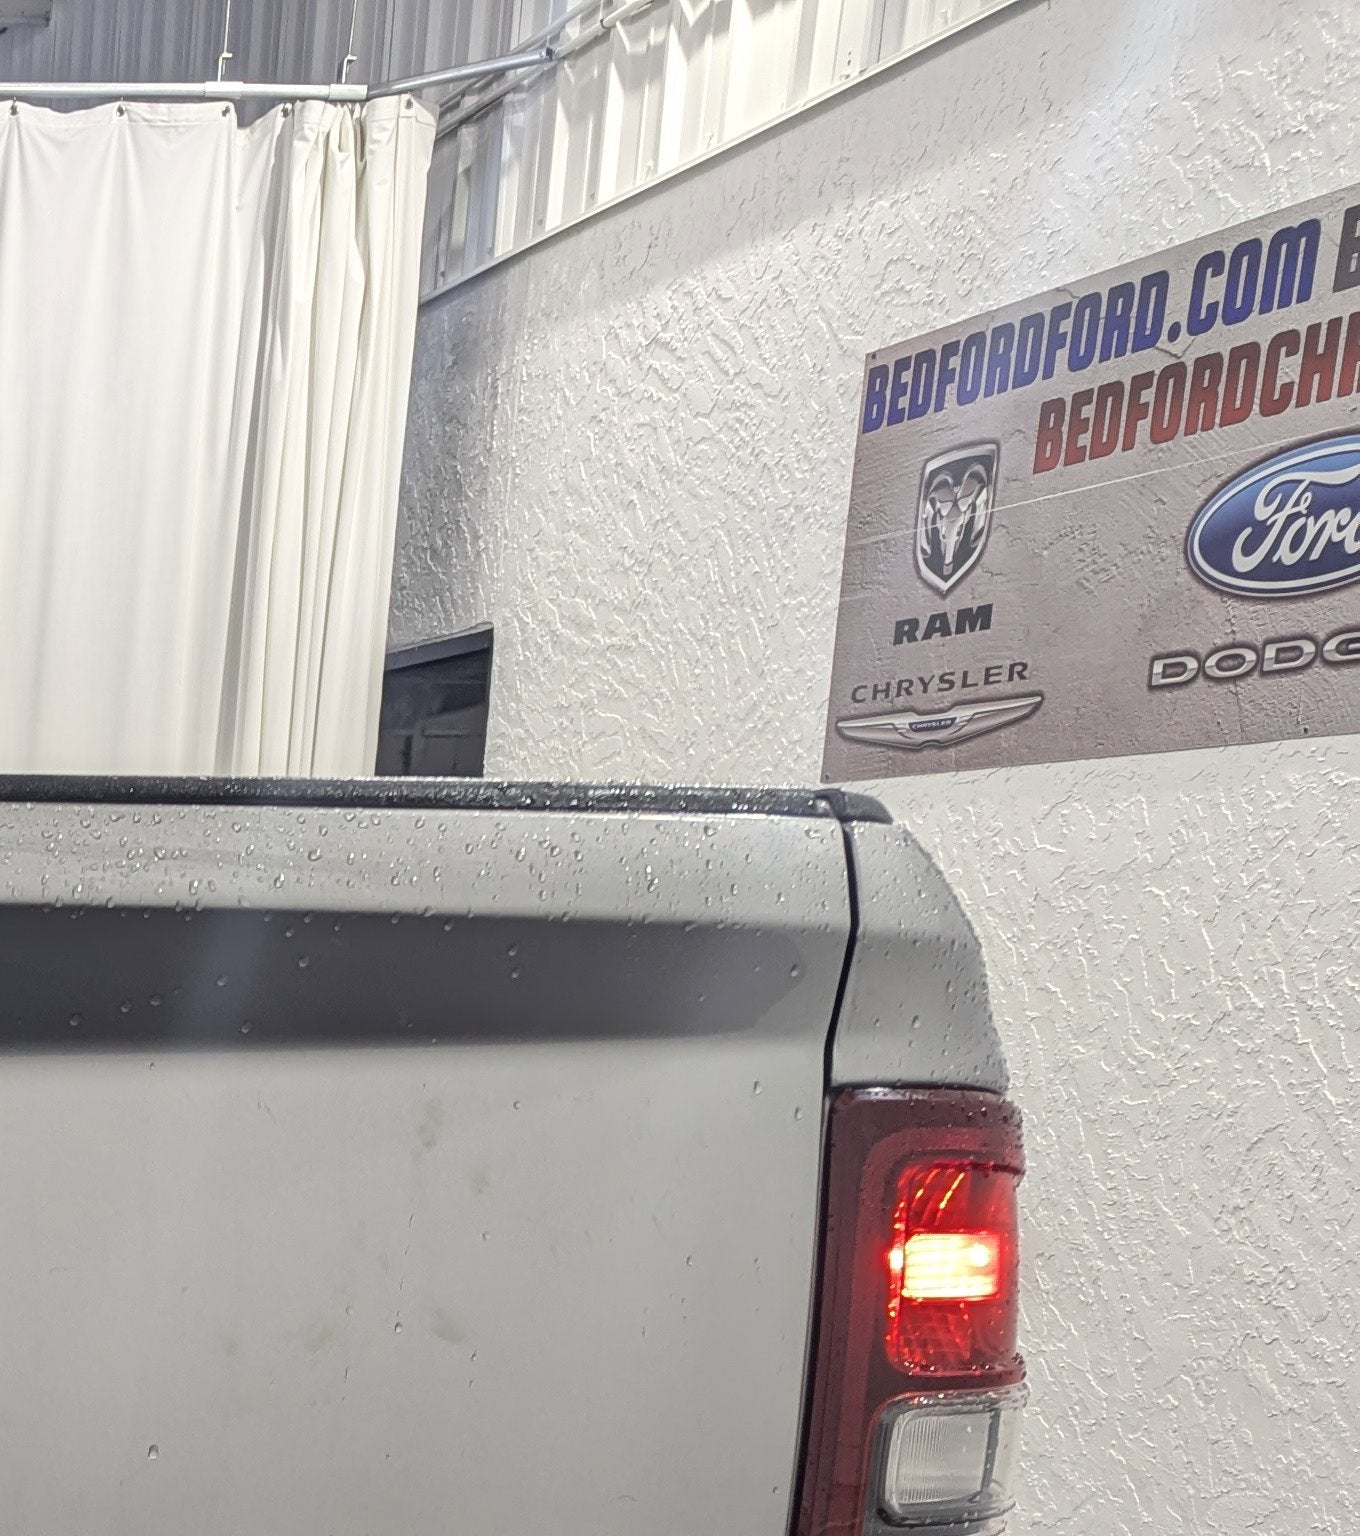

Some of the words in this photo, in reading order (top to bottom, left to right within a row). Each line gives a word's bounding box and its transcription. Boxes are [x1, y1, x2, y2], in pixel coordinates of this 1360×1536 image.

[862, 218, 1321, 433] BEDFORDFORD.COM
[893, 604, 993, 646] RAM
[851, 661, 1028, 703] CHRYSLER
[911, 719, 953, 730] CHRYSLER
